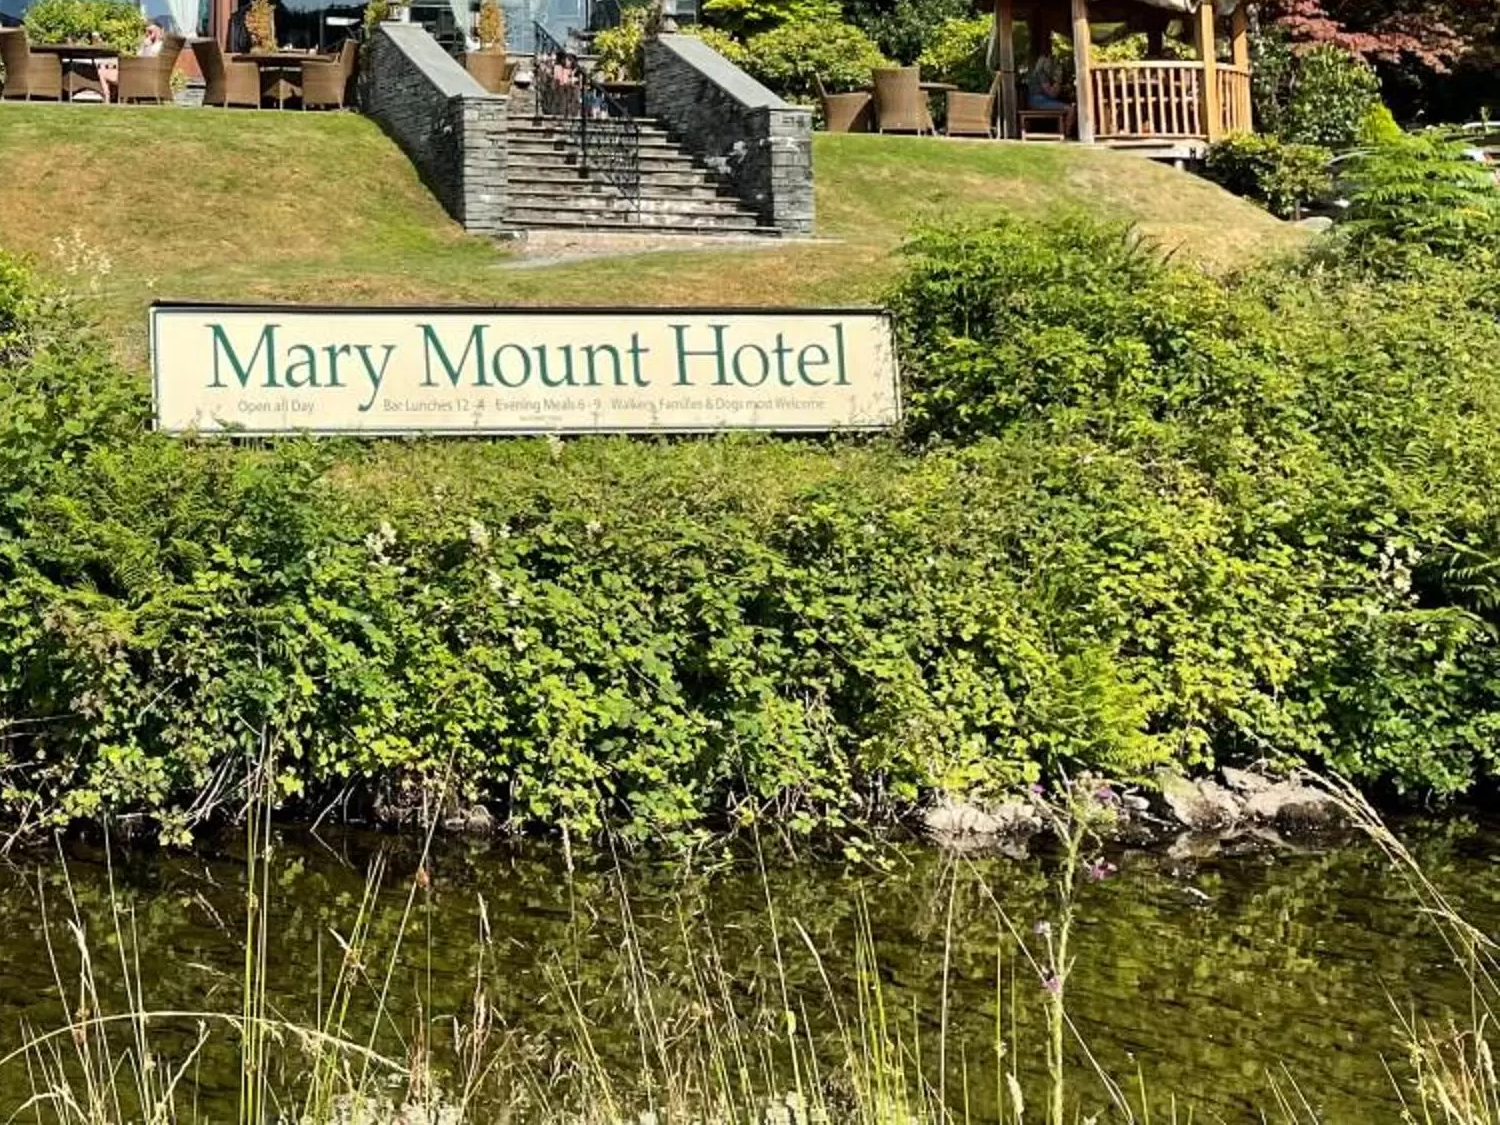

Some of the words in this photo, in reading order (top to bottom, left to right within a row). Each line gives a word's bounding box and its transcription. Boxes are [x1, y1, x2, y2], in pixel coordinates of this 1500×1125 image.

[204, 323, 397, 412] Mary
[415, 322, 651, 389] Mount
[667, 321, 852, 387] Hotel
[238, 399, 271, 414] Open
[291, 399, 314, 415] Day
[405, 398, 453, 412] Lunches
[457, 398, 469, 411] 12
[495, 398, 541, 413] Evening
[543, 397, 576, 411] Meals
[577, 399, 586, 411] 6
[706, 398, 714, 410] &
[715, 397, 743, 411] Dogs
[775, 397, 826, 411] Welcome
